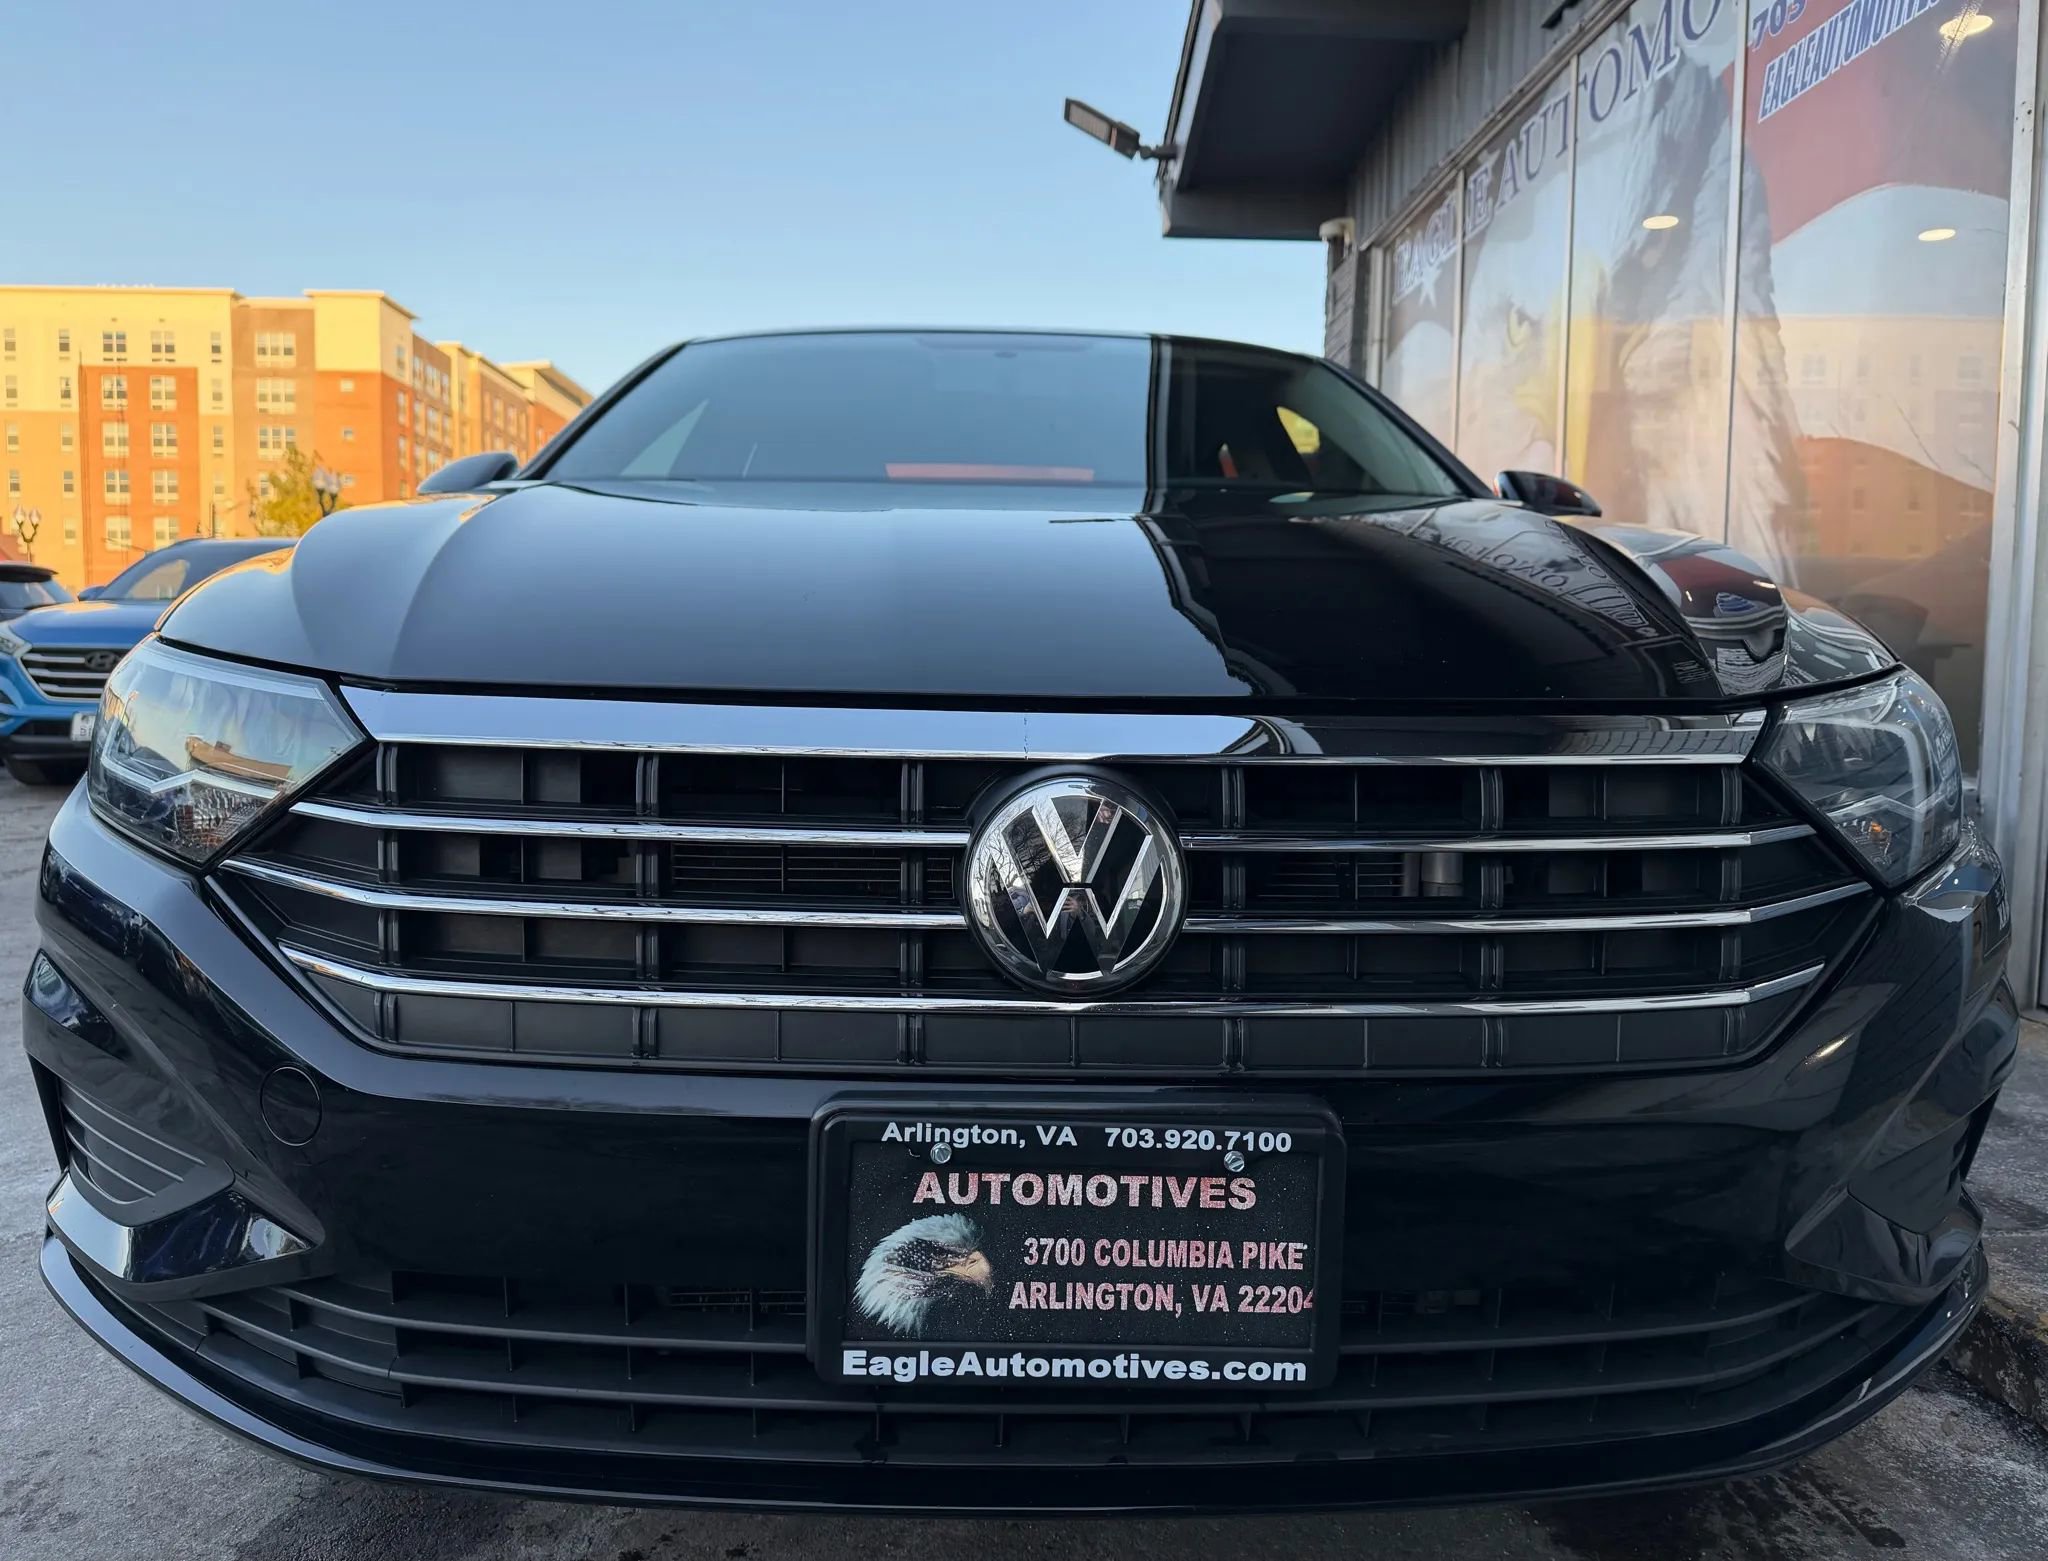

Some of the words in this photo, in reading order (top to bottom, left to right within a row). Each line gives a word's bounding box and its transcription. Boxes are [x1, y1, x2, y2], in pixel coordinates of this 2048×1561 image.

[881, 1121, 1026, 1149] Arlington,
[1035, 1125, 1078, 1146] VA
[1104, 1127, 1292, 1153] 703.920.7100
[912, 1171, 1257, 1210] AUTOMOTIVES
[1023, 1237, 1086, 1266] 3700
[1094, 1238, 1235, 1269] COLUMBIA
[1242, 1241, 1305, 1270] PIKE
[1008, 1281, 1182, 1319] ARLINGTON,
[1191, 1284, 1230, 1312] VA
[842, 1350, 1307, 1382] EagleAutomotives.com
